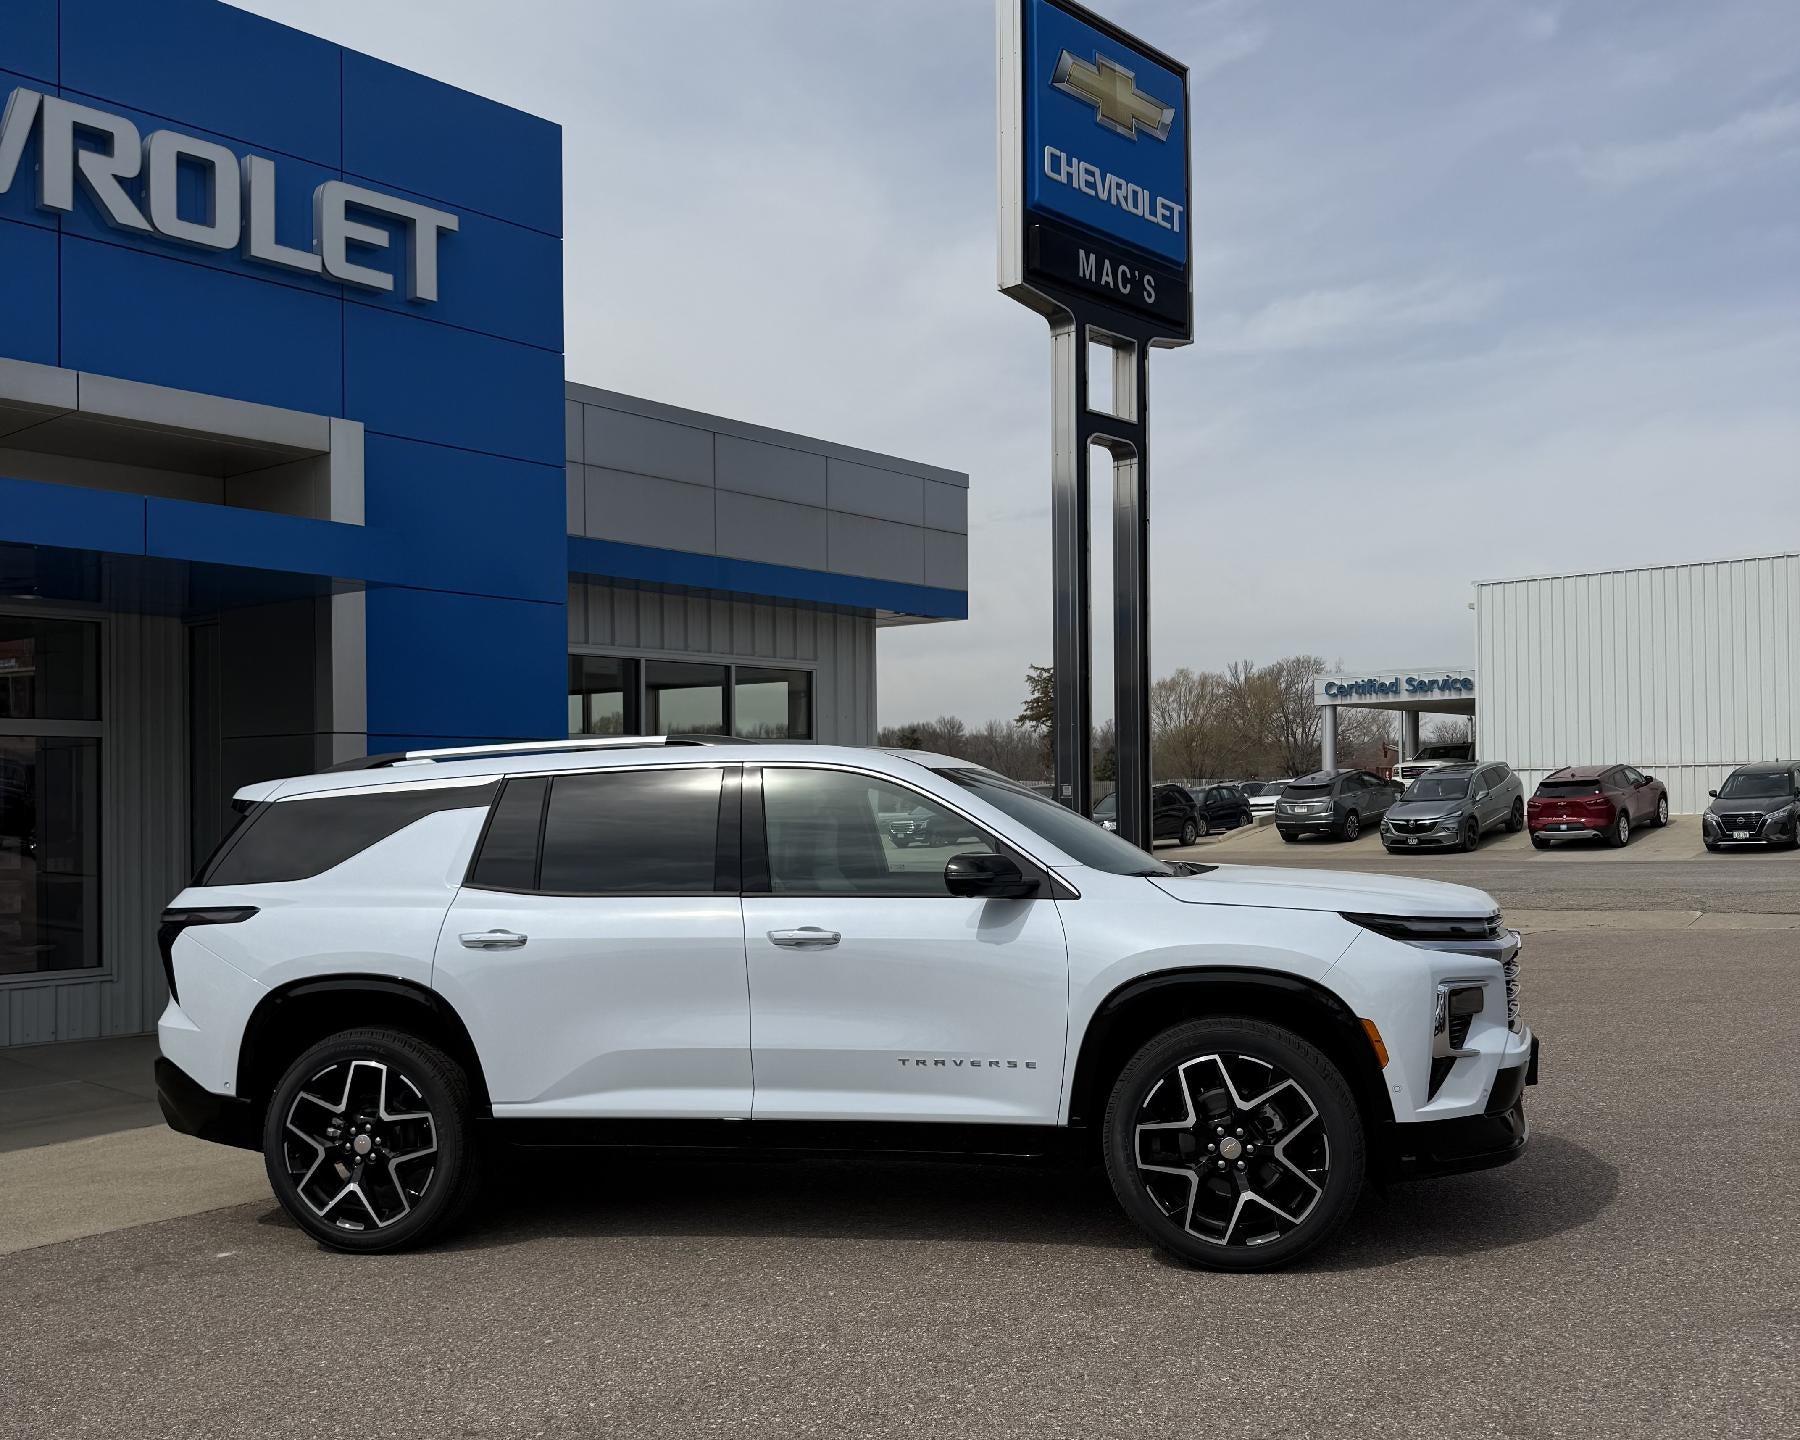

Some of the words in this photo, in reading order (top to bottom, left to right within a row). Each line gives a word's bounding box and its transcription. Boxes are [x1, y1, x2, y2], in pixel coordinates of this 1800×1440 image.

[1045, 145, 1184, 233] CHEVROLET
[1078, 248, 1156, 305] MAC'S
[1325, 677, 1400, 698] Certified
[1405, 674, 1474, 693] Service
[898, 1058, 1037, 1070] TRAVERSE
